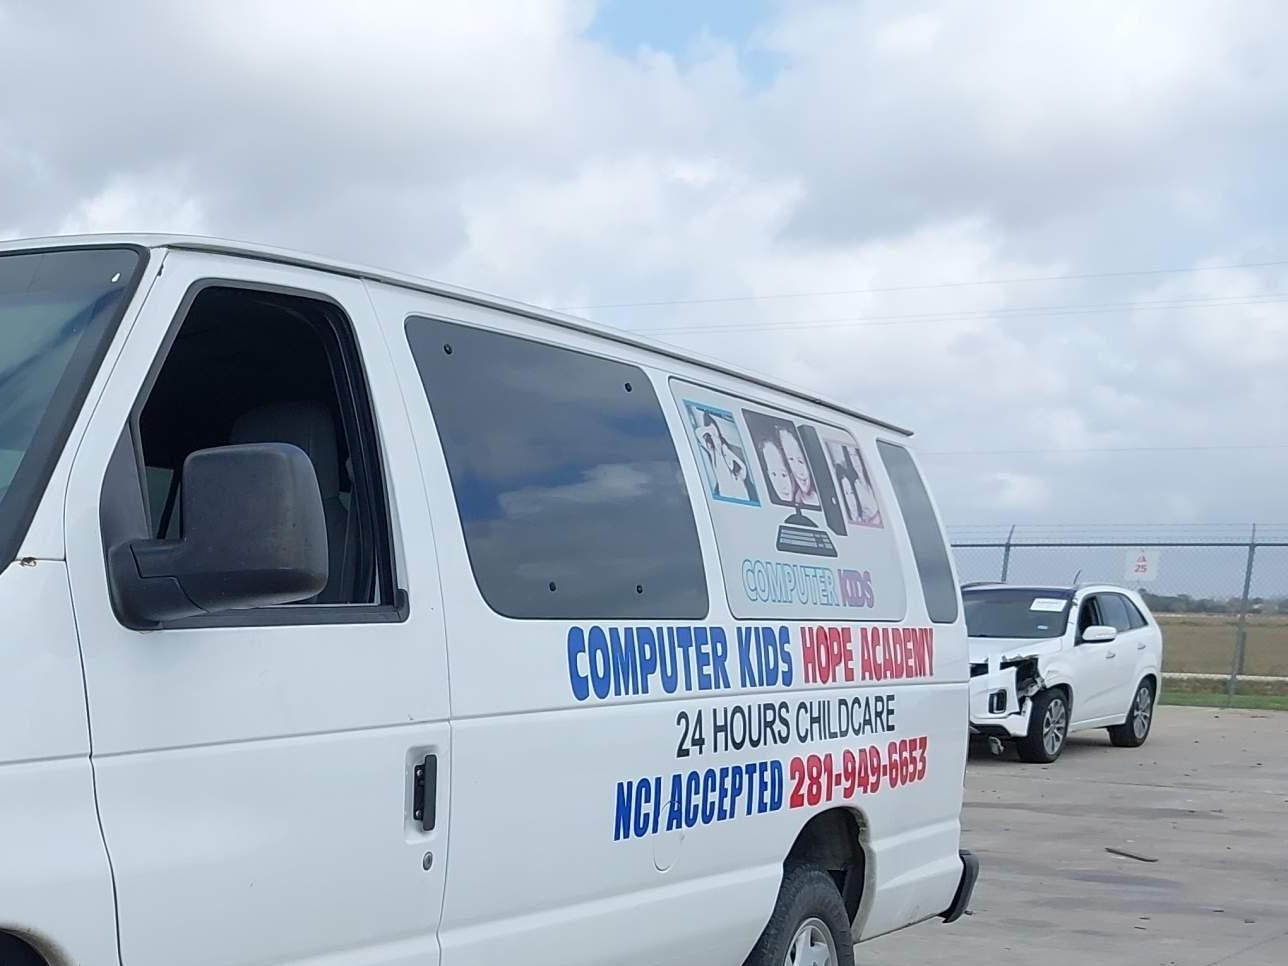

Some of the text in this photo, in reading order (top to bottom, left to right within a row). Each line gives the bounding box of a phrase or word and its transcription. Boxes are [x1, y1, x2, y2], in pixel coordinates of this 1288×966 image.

[742, 559, 874, 609] COMPUTER KIDS
[566, 625, 934, 701] COMPUTER KIDS HOPE ACADEMY
[676, 694, 896, 758] 24 HOURS CHILDCARE
[614, 736, 928, 841] NCI ACCEPTED 281-949-6653
